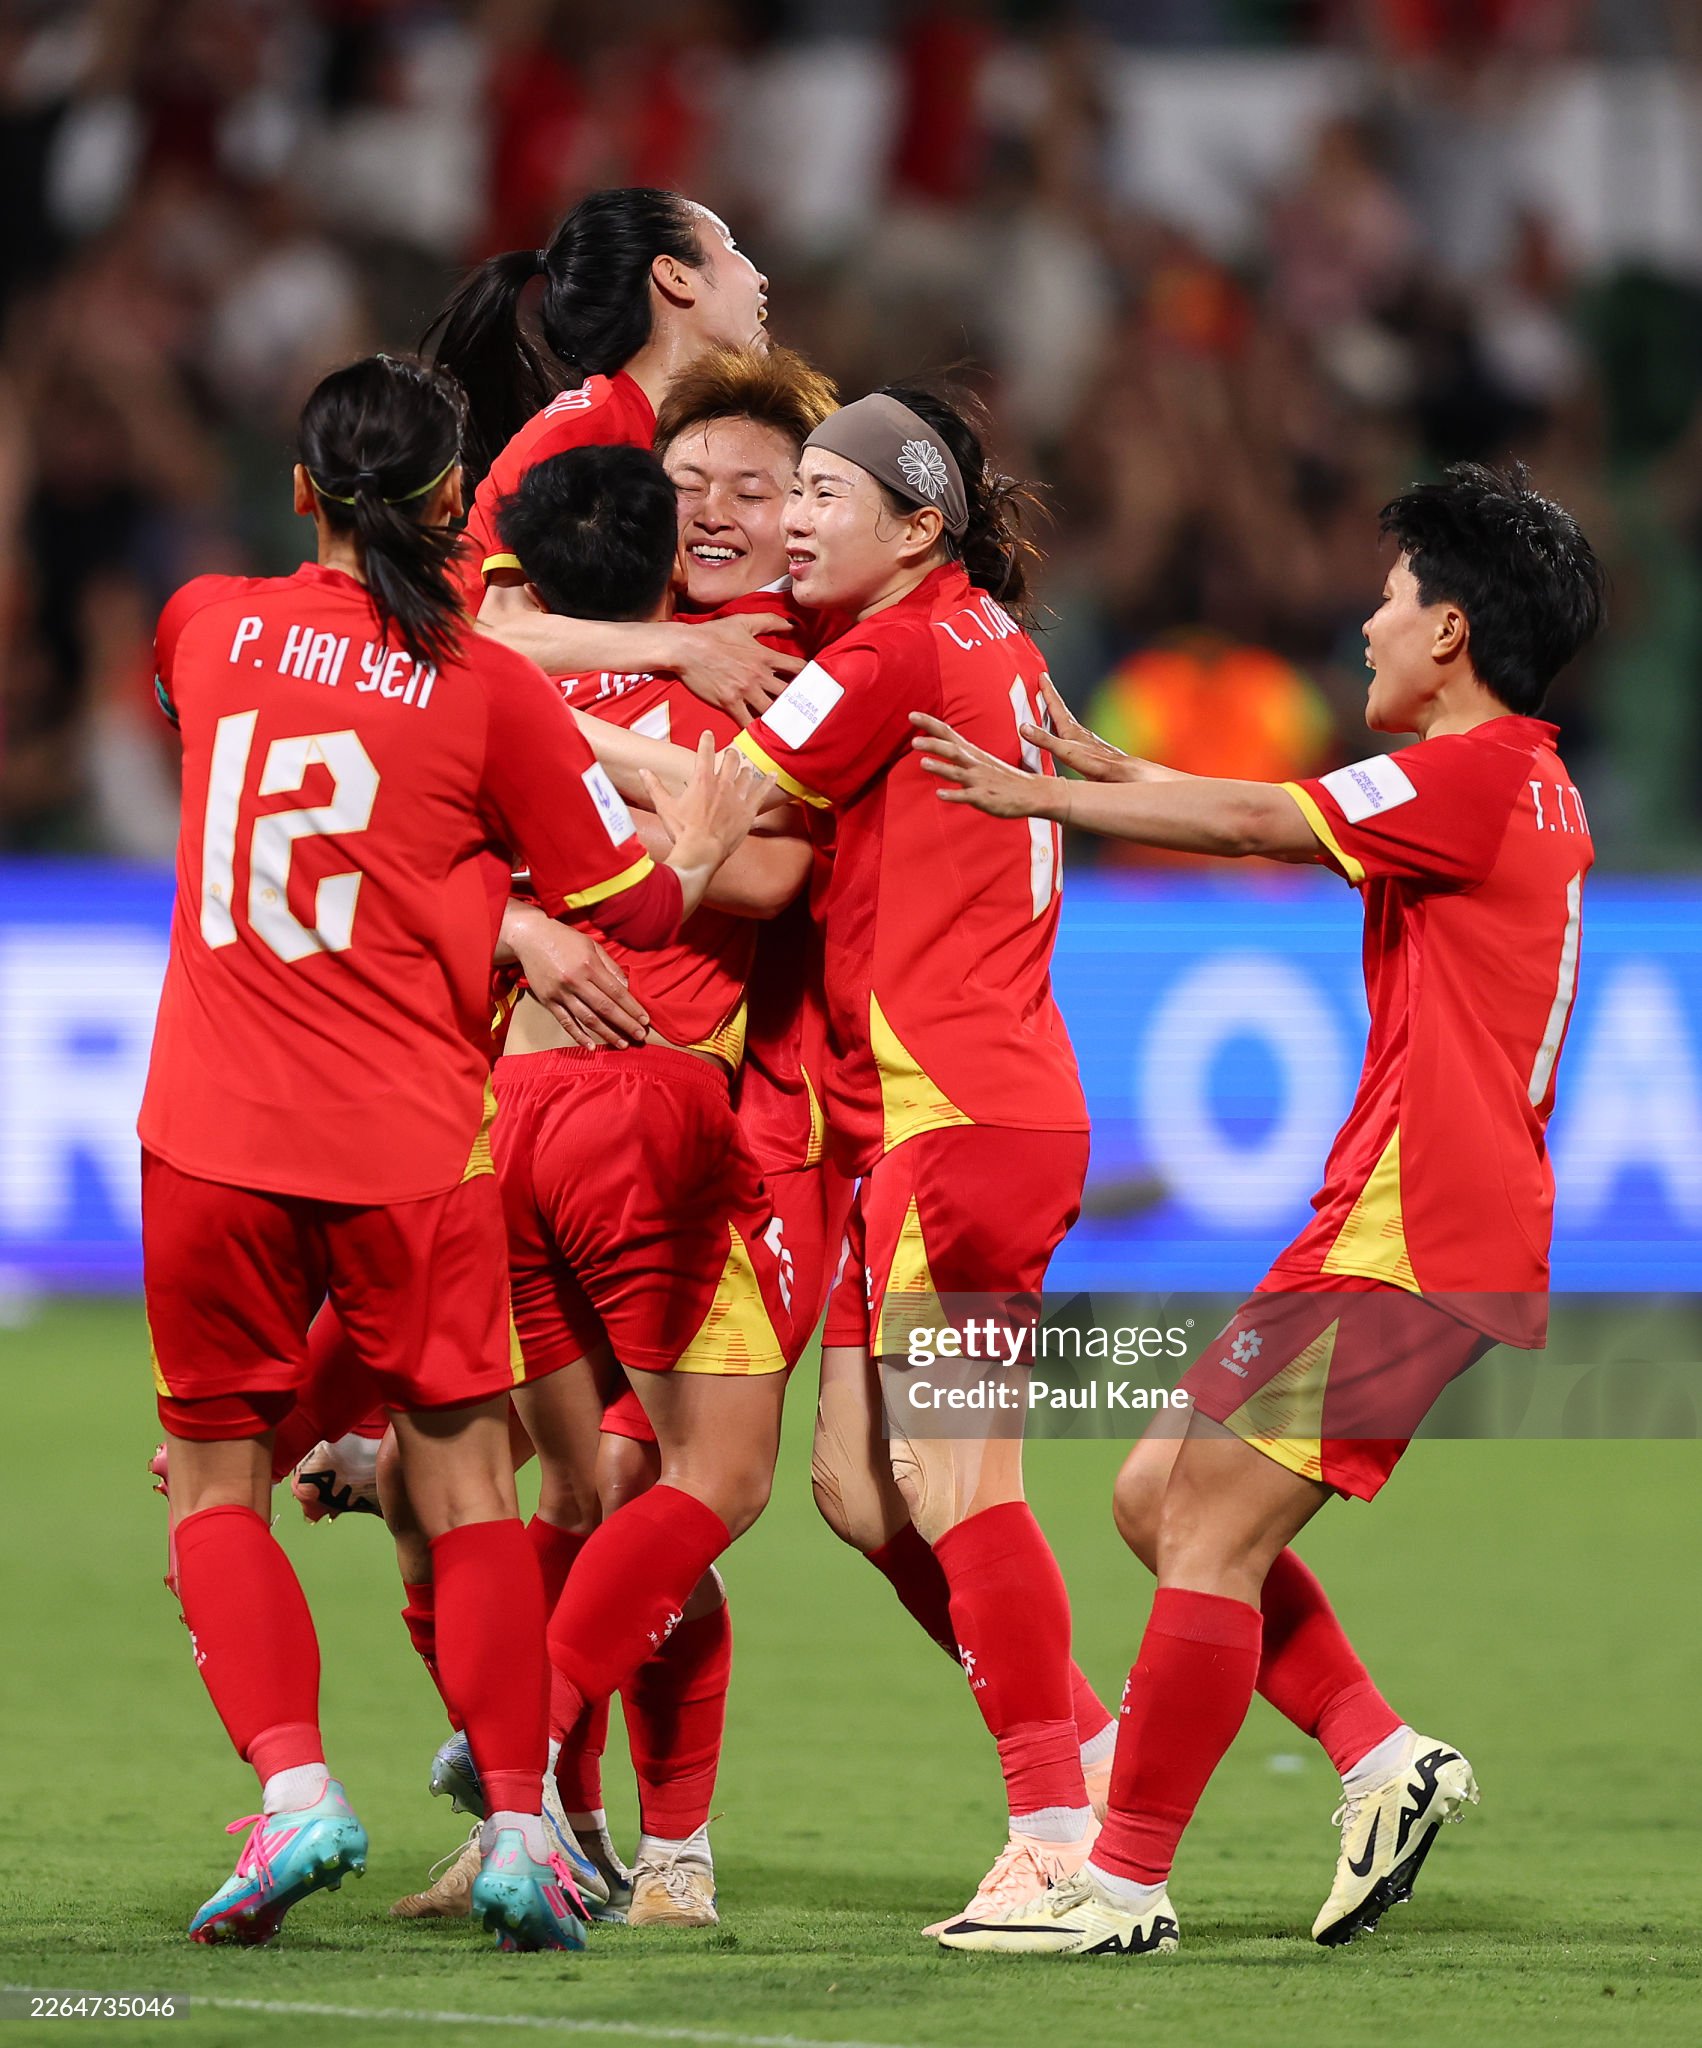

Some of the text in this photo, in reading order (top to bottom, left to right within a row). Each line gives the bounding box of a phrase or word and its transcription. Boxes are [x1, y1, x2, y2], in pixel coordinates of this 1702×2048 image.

[229, 615, 263, 669] P.
[277, 624, 351, 687] HAI
[1347, 768, 1382, 809] FEARLESS
[1358, 770, 1384, 801] DREAM
[199, 709, 381, 963] 12
